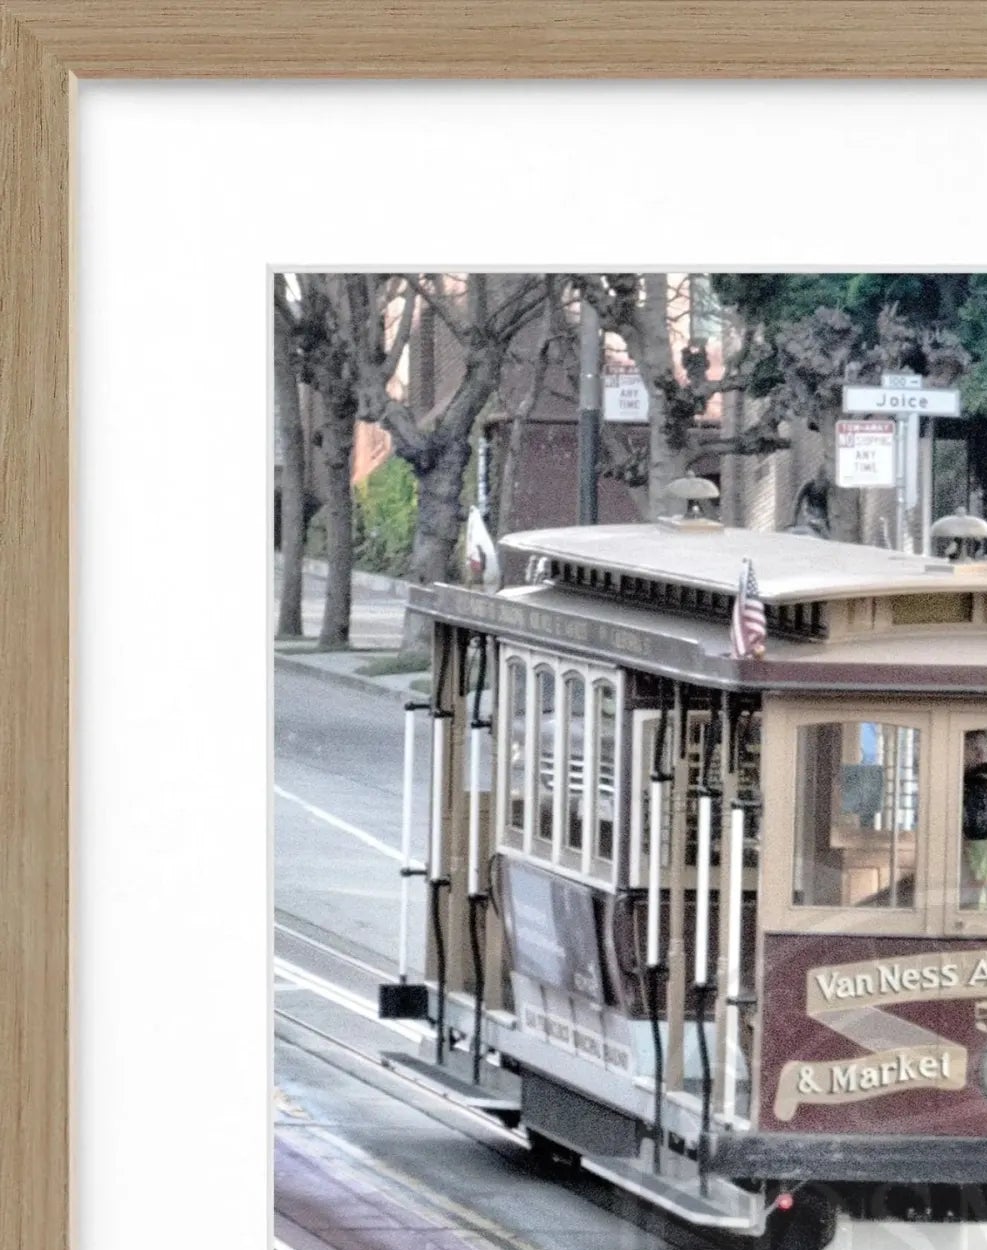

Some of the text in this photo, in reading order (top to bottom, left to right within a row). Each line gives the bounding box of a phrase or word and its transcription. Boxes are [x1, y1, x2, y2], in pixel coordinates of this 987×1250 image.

[876, 393, 928, 409] Joice
[856, 451, 876, 460] ANY
[855, 462, 878, 473] TIME
[816, 972, 872, 1001] Van
[879, 963, 958, 995] Ness
[797, 1053, 951, 1095] & Market
